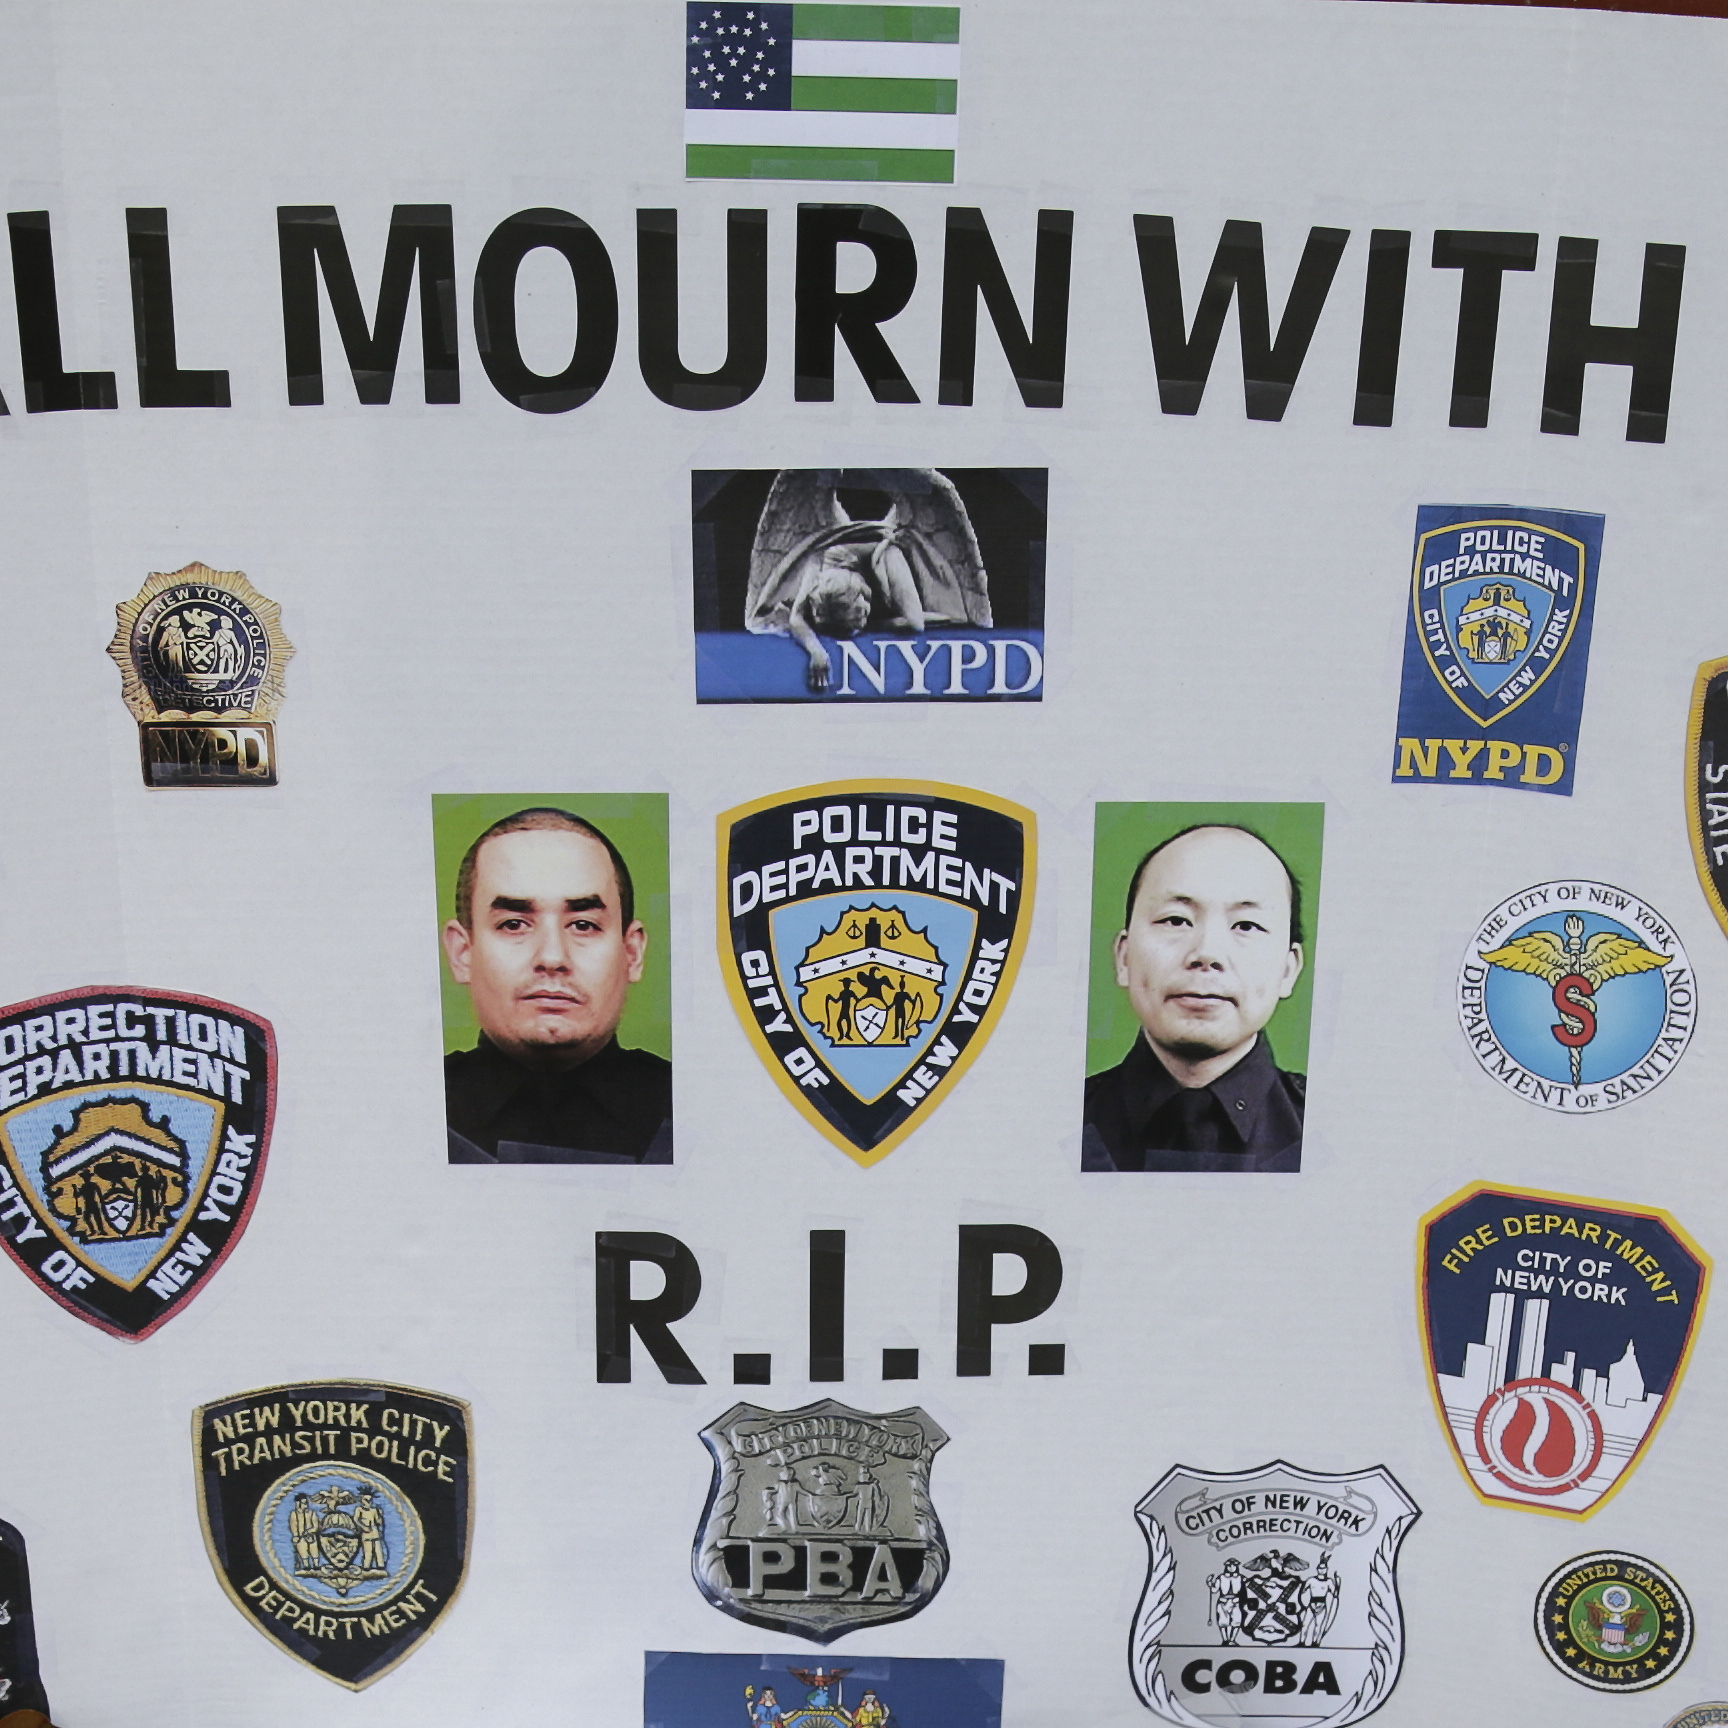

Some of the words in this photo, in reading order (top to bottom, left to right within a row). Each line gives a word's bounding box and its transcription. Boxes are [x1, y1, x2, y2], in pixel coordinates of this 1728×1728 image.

[276, 202, 1074, 414] MOURN
[1133, 212, 1687, 444] WITH
[1459, 530, 1545, 558] POLICE
[1424, 553, 1574, 597] DEPARTMENT
[140, 614, 156, 635] OF
[156, 587, 189, 612] NEW
[196, 587, 243, 613] YORK
[243, 614, 267, 679] POLICE
[1424, 608, 1450, 658] CITY
[1445, 665, 1468, 689] OF
[1498, 666, 1536, 704] NEW
[1534, 608, 1570, 660] YORK
[836, 639, 1043, 696] NYPD
[159, 689, 254, 708] DETECTIVE
[150, 728, 268, 777] NYPD
[793, 805, 958, 851] POLICE
[732, 846, 1016, 918] DEPARTMENT
[1477, 914, 1507, 948] THE
[1509, 889, 1549, 917] CITY
[1557, 886, 1582, 901] OF
[1589, 888, 1631, 911] NEW
[1635, 906, 1676, 952] YORK
[741, 950, 794, 1035] CITY
[784, 1047, 830, 1089] OF
[896, 1034, 960, 1107] NEW
[952, 938, 1009, 1024] YORK
[1462, 963, 1571, 1107] DEPARTMENT
[1575, 1094, 1599, 1109] OF
[1603, 968, 1692, 1105] SANITATION
[41, 1249, 95, 1292] OF
[146, 1232, 211, 1300] NEW
[198, 1125, 256, 1223] YORK
[1441, 1224, 1500, 1274] FIRE
[1502, 1214, 1679, 1305] DEPARTMENT
[1517, 1249, 1571, 1273] CITY
[1578, 1259, 1613, 1279] OF
[595, 1224, 1066, 1385] R.I.P.
[1495, 1268, 1556, 1293] NEW
[1557, 1277, 1628, 1306] YORK
[213, 1404, 281, 1442] NEW
[287, 1400, 370, 1427] YORK
[381, 1408, 450, 1448] CITY
[736, 1421, 784, 1457] CITY
[211, 1430, 341, 1477] TRANSIT
[350, 1431, 457, 1483] POLICE
[779, 1438, 882, 1464] POLICE
[1185, 1501, 1224, 1532] CITY
[1231, 1496, 1257, 1514] OF
[1264, 1494, 1310, 1511] NEW
[1314, 1500, 1367, 1532] YORK
[1215, 1518, 1334, 1544] CORRECTION
[746, 1541, 905, 1600] PBA
[1559, 1564, 1618, 1596] UNITED
[1624, 1568, 1674, 1611] STATES
[243, 1576, 438, 1640] DEPARTMENT
[1181, 1658, 1342, 1696] COBA
[1578, 1660, 1638, 1679] ARMY
